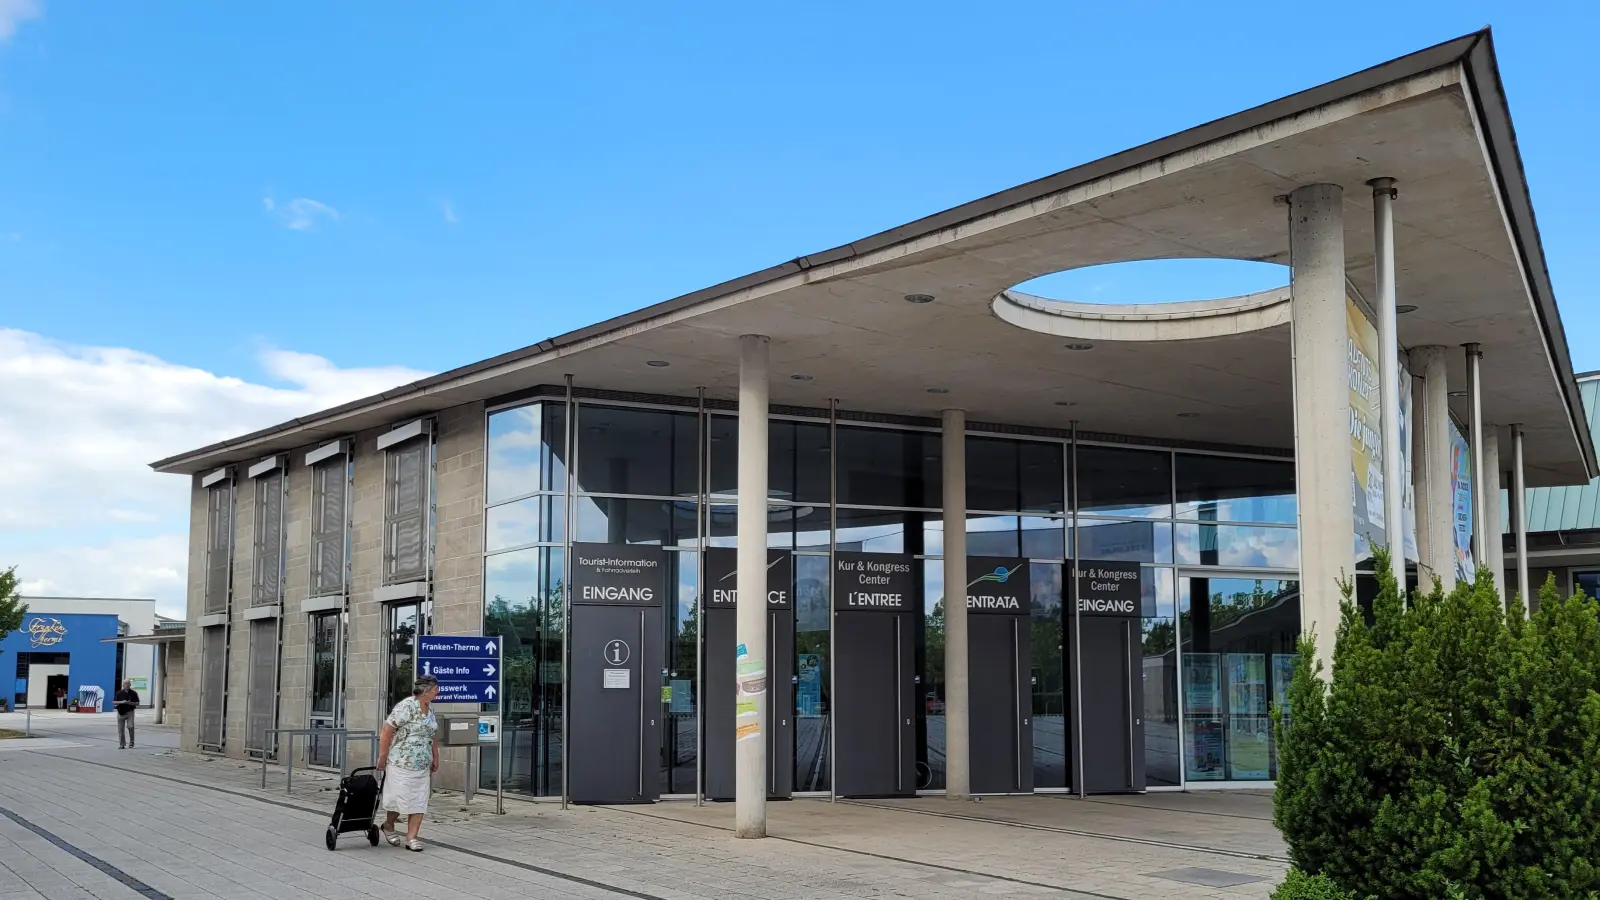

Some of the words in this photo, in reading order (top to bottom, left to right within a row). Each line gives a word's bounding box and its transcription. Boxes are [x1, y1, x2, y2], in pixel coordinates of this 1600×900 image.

[1348, 406, 1362, 440] Die
[578, 557, 658, 568] Tourist-Information
[838, 560, 855, 571] Kur
[857, 560, 865, 571] &
[867, 561, 910, 574] Kongress
[858, 573, 891, 585] Center
[1089, 568, 1096, 578] &
[1097, 569, 1138, 581] Kongress
[1090, 580, 1120, 592] Center
[583, 586, 654, 601] EINGANG
[713, 589, 787, 604] ENTCE
[966, 595, 1020, 609] ENTRATA
[1078, 598, 1135, 613] EINGANG
[421, 642, 480, 652] Franken-Therme
[433, 666, 454, 675] Gäste
[455, 666, 470, 675] Info
